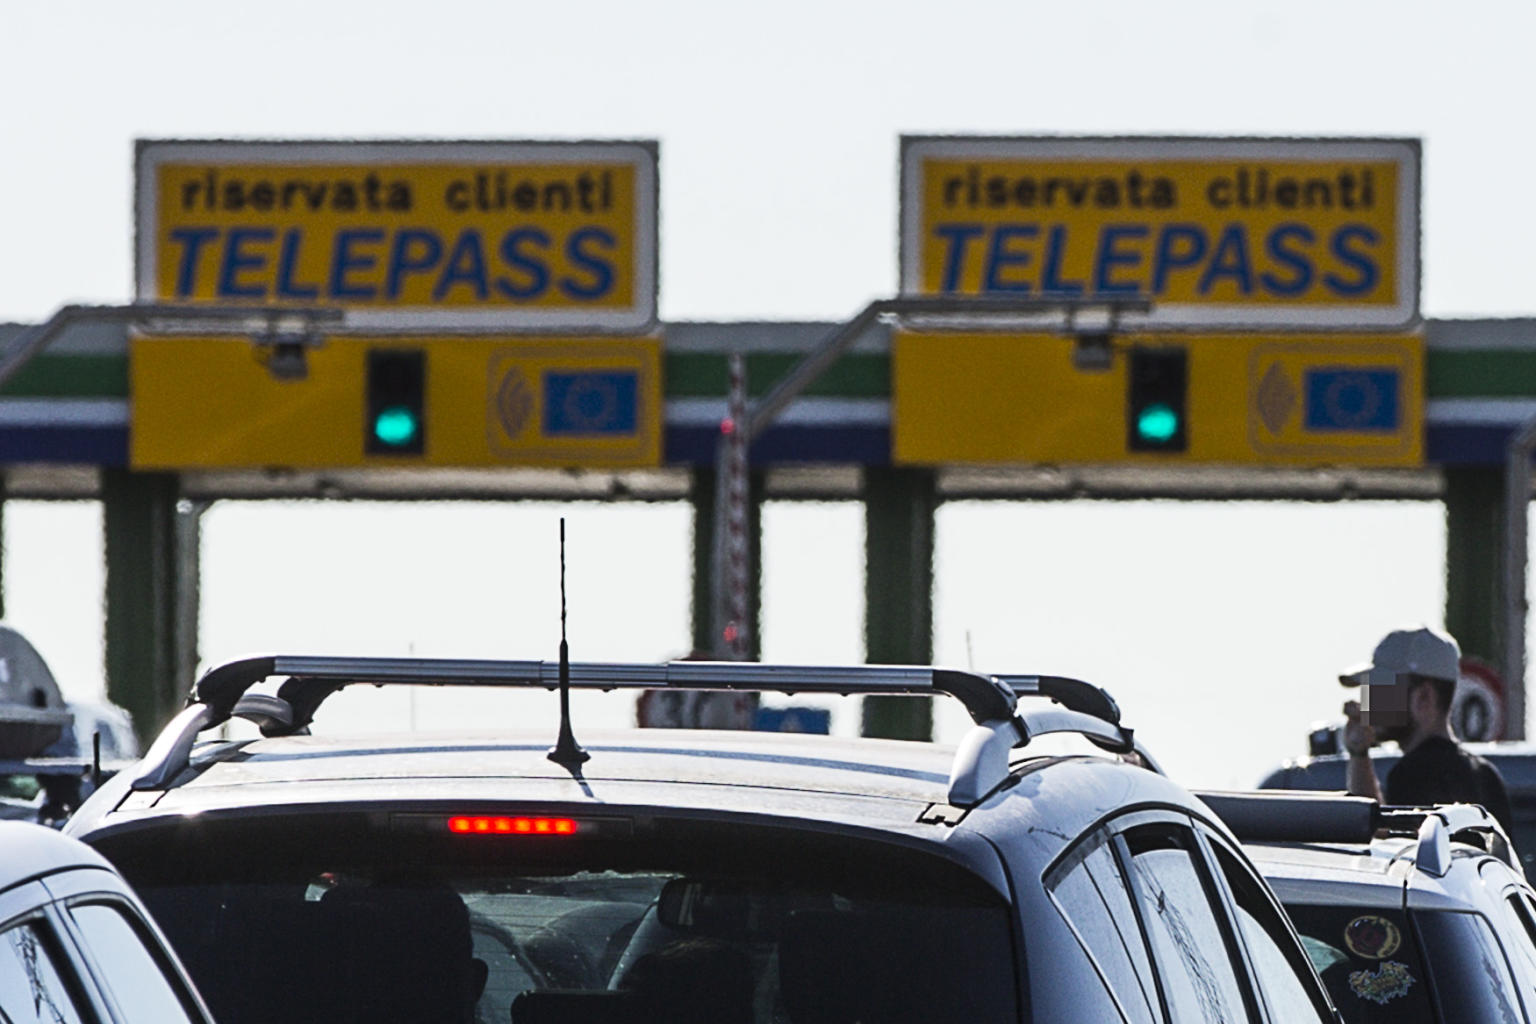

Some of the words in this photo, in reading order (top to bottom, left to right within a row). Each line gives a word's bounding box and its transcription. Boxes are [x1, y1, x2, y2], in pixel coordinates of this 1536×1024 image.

[181, 170, 413, 212] riservata
[445, 170, 614, 212] clienti
[942, 167, 1176, 209] riservata
[1207, 167, 1375, 209] clienti
[167, 225, 619, 301] TELEPASS
[933, 221, 1382, 298] TELEPASS
